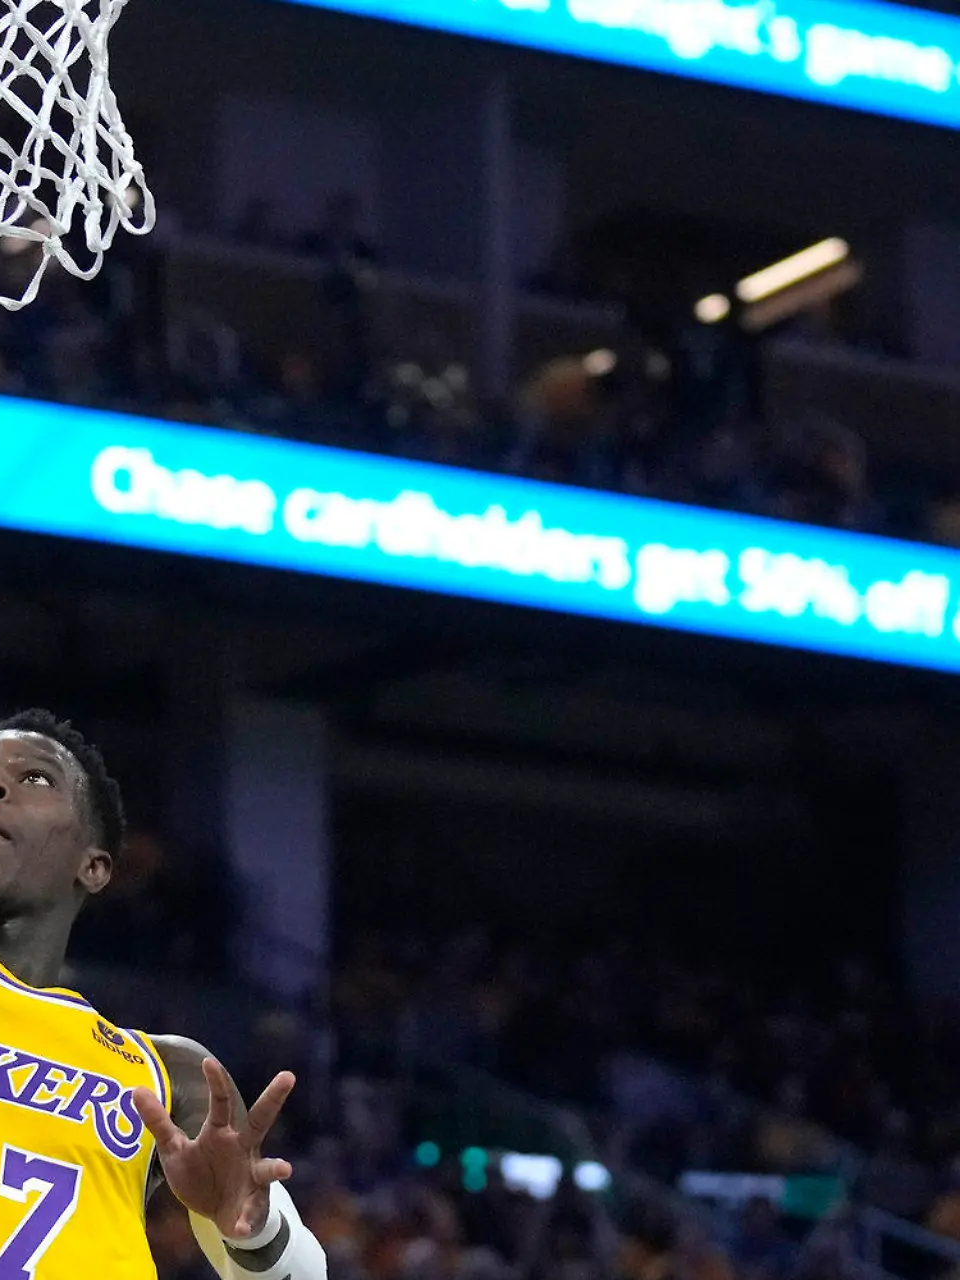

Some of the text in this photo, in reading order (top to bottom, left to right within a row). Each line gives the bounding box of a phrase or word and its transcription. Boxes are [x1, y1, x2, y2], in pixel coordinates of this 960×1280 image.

[90, 446, 276, 535] Chase
[283, 488, 631, 590] cardholders
[739, 547, 860, 626] 50%
[91, 1028, 145, 1065] bibigo
